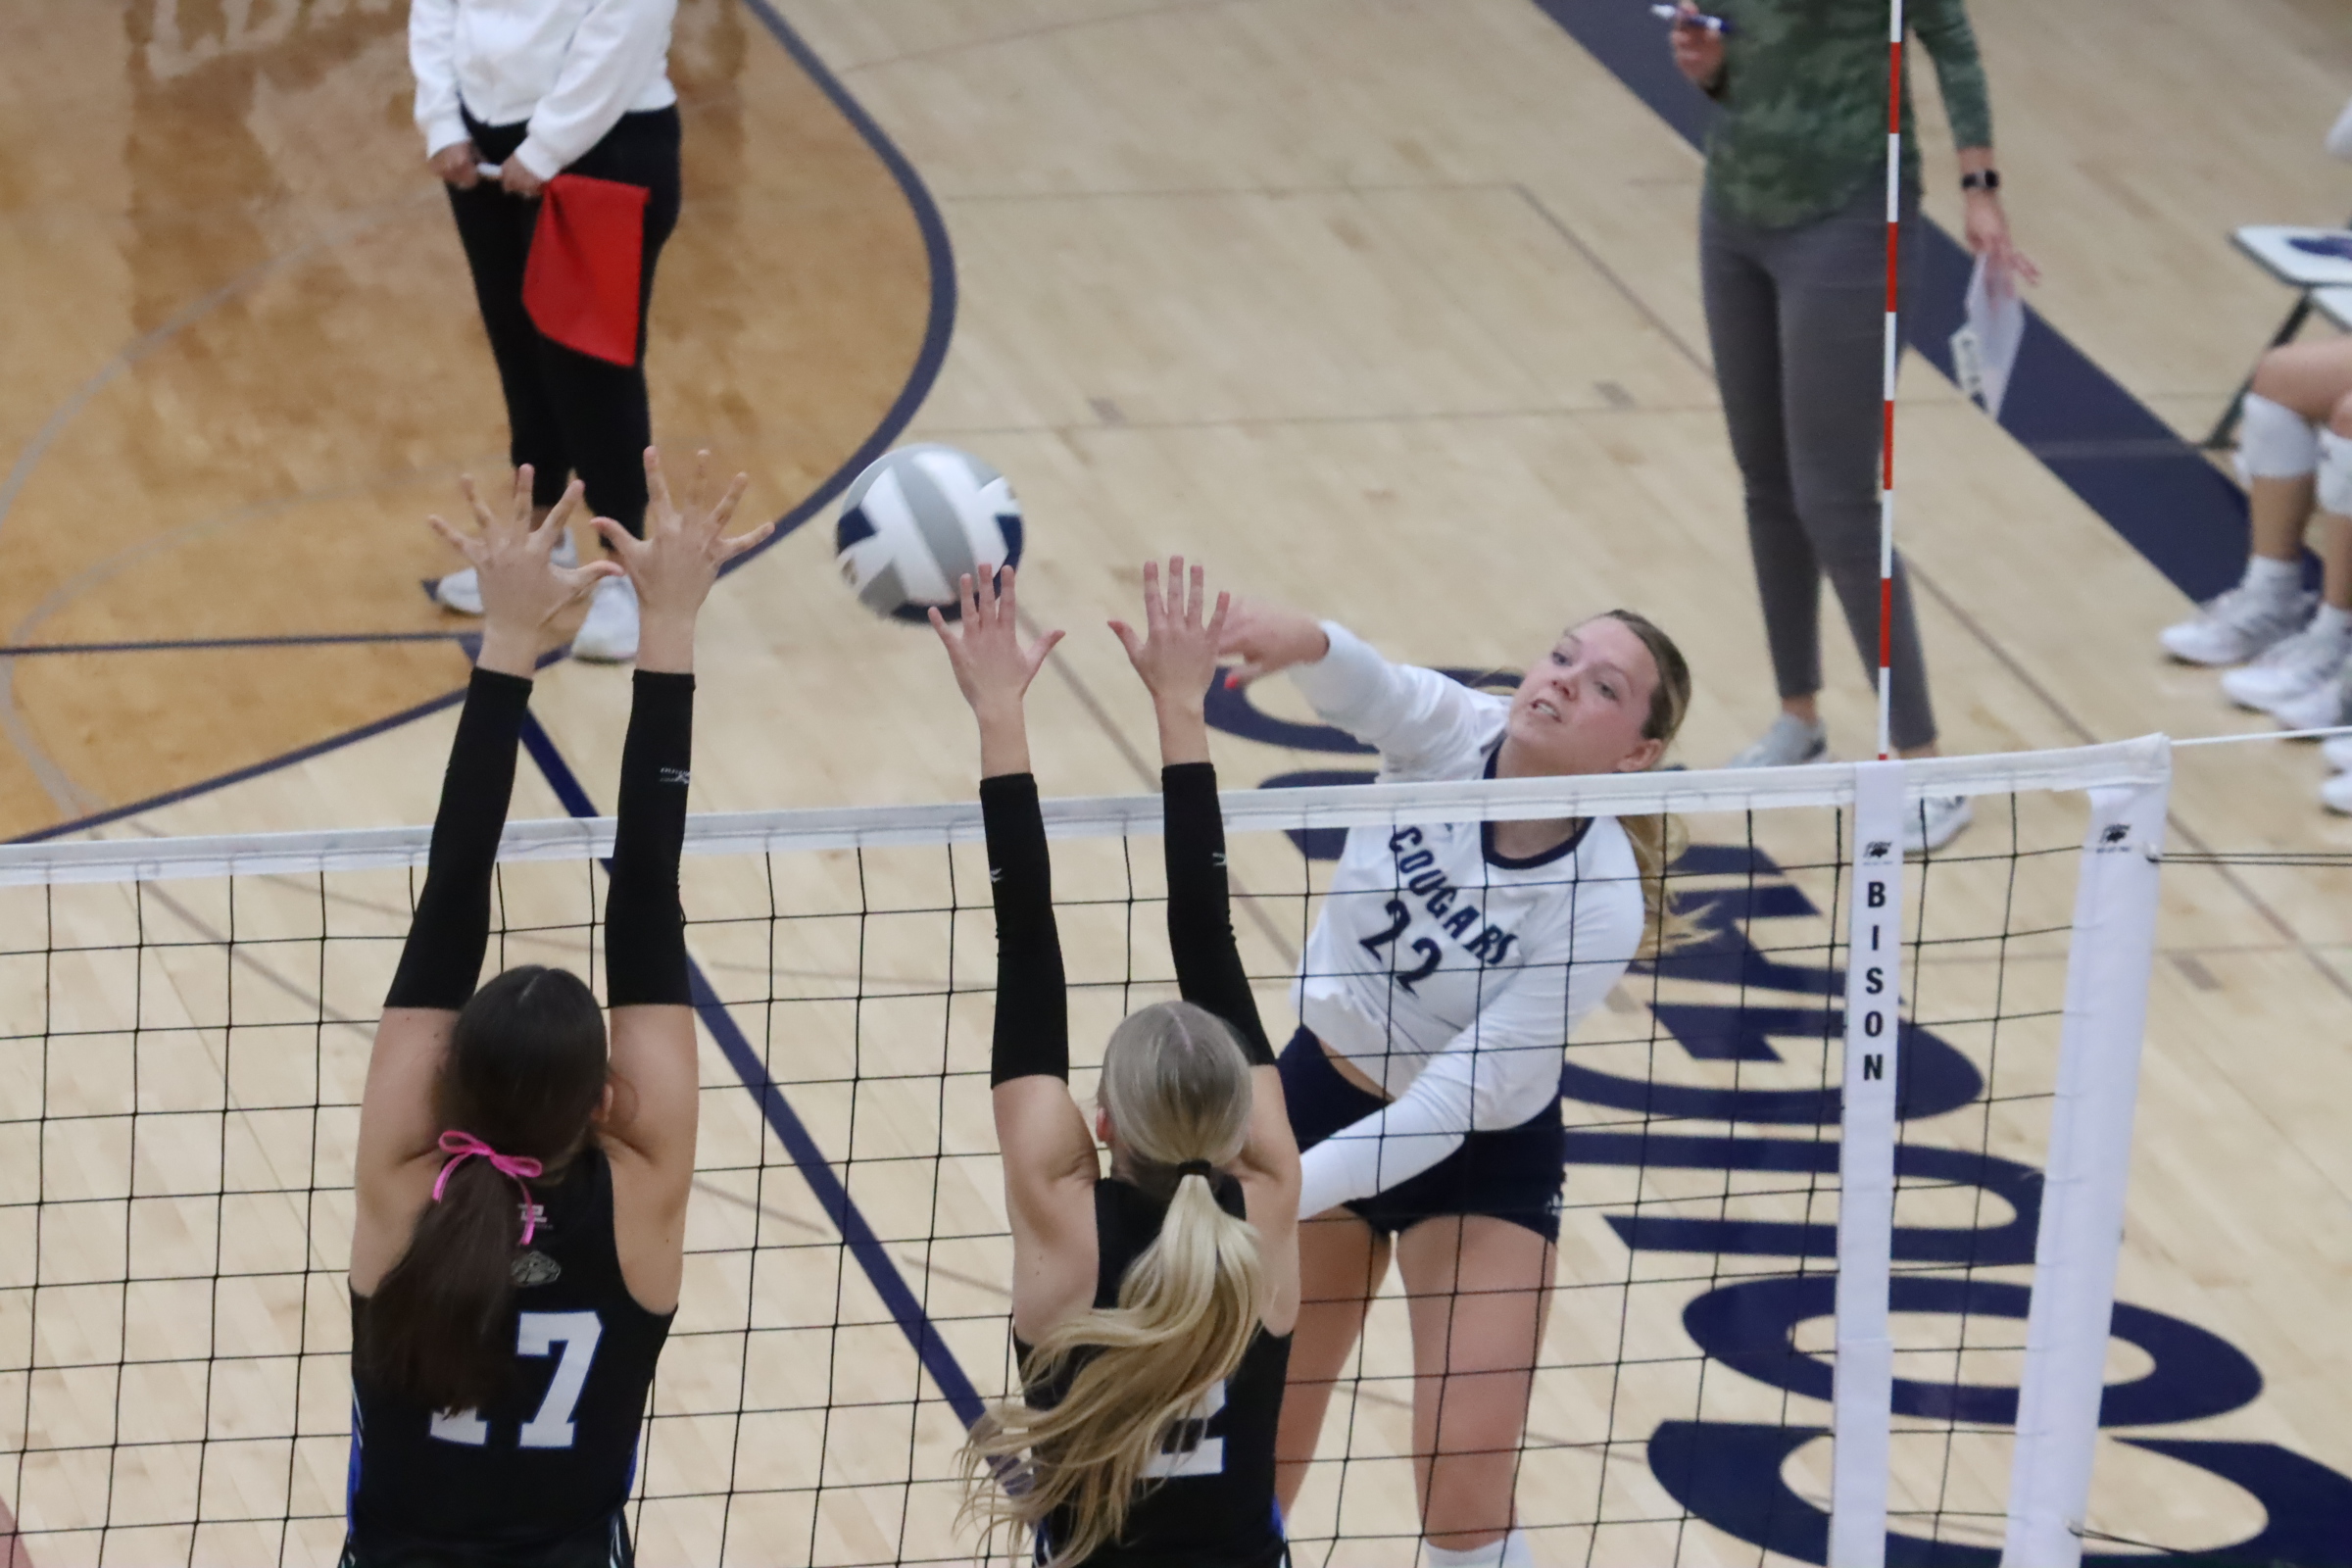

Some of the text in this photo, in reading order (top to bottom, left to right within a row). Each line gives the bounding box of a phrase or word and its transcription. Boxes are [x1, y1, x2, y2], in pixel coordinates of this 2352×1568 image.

[1359, 899, 1443, 999] 22
[1389, 825, 1518, 965] COUGARS
[1863, 881, 1886, 1081] BISON
